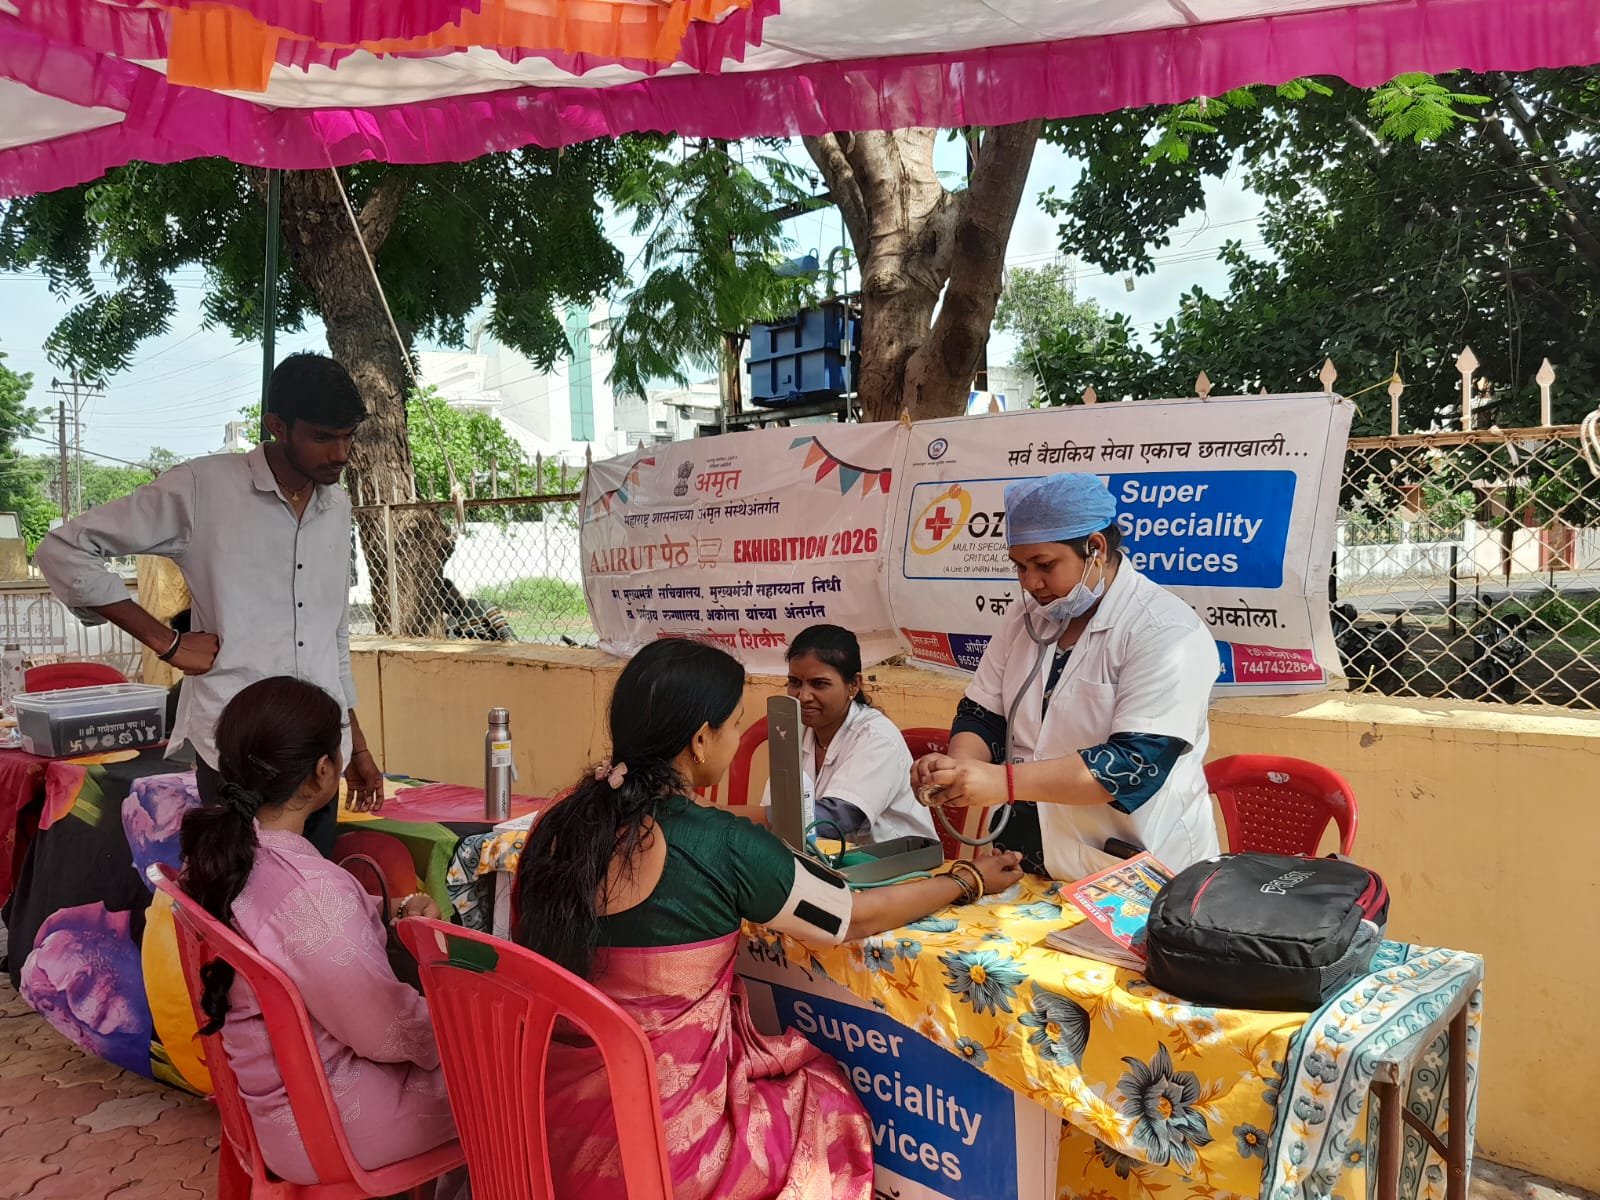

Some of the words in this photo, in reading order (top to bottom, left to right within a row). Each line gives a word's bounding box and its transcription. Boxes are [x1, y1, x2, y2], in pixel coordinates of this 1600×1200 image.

[1008, 442, 1033, 467] सर्व
[1037, 440, 1095, 464] वैद्यकिय
[1101, 438, 1133, 463] सेवा
[1140, 441, 1192, 464] एकाच
[695, 469, 742, 498] अमृत
[1121, 480, 1208, 508] Super
[652, 509, 694, 524] शासनाच्या
[968, 512, 1006, 538] OZ
[1117, 512, 1263, 543] Speciality
[590, 544, 657, 573] AMRUT
[660, 533, 690, 569] पेठ
[734, 535, 829, 563] EXHIBITION
[830, 527, 878, 557] 2026
[952, 543, 975, 552] MULTI
[978, 543, 1010, 552] SPECIAL
[963, 554, 999, 562] CRITICAL
[1117, 546, 1239, 573] ervices
[709, 581, 753, 603] मुख्यमंत्री
[812, 575, 842, 593] निधी
[706, 605, 739, 621] अकोला
[745, 604, 777, 620] यांच्या
[784, 601, 826, 619] अंतर्गत
[793, 1001, 903, 1057] Super
[837, 1059, 982, 1146] eciality
[871, 1121, 962, 1181] vices
